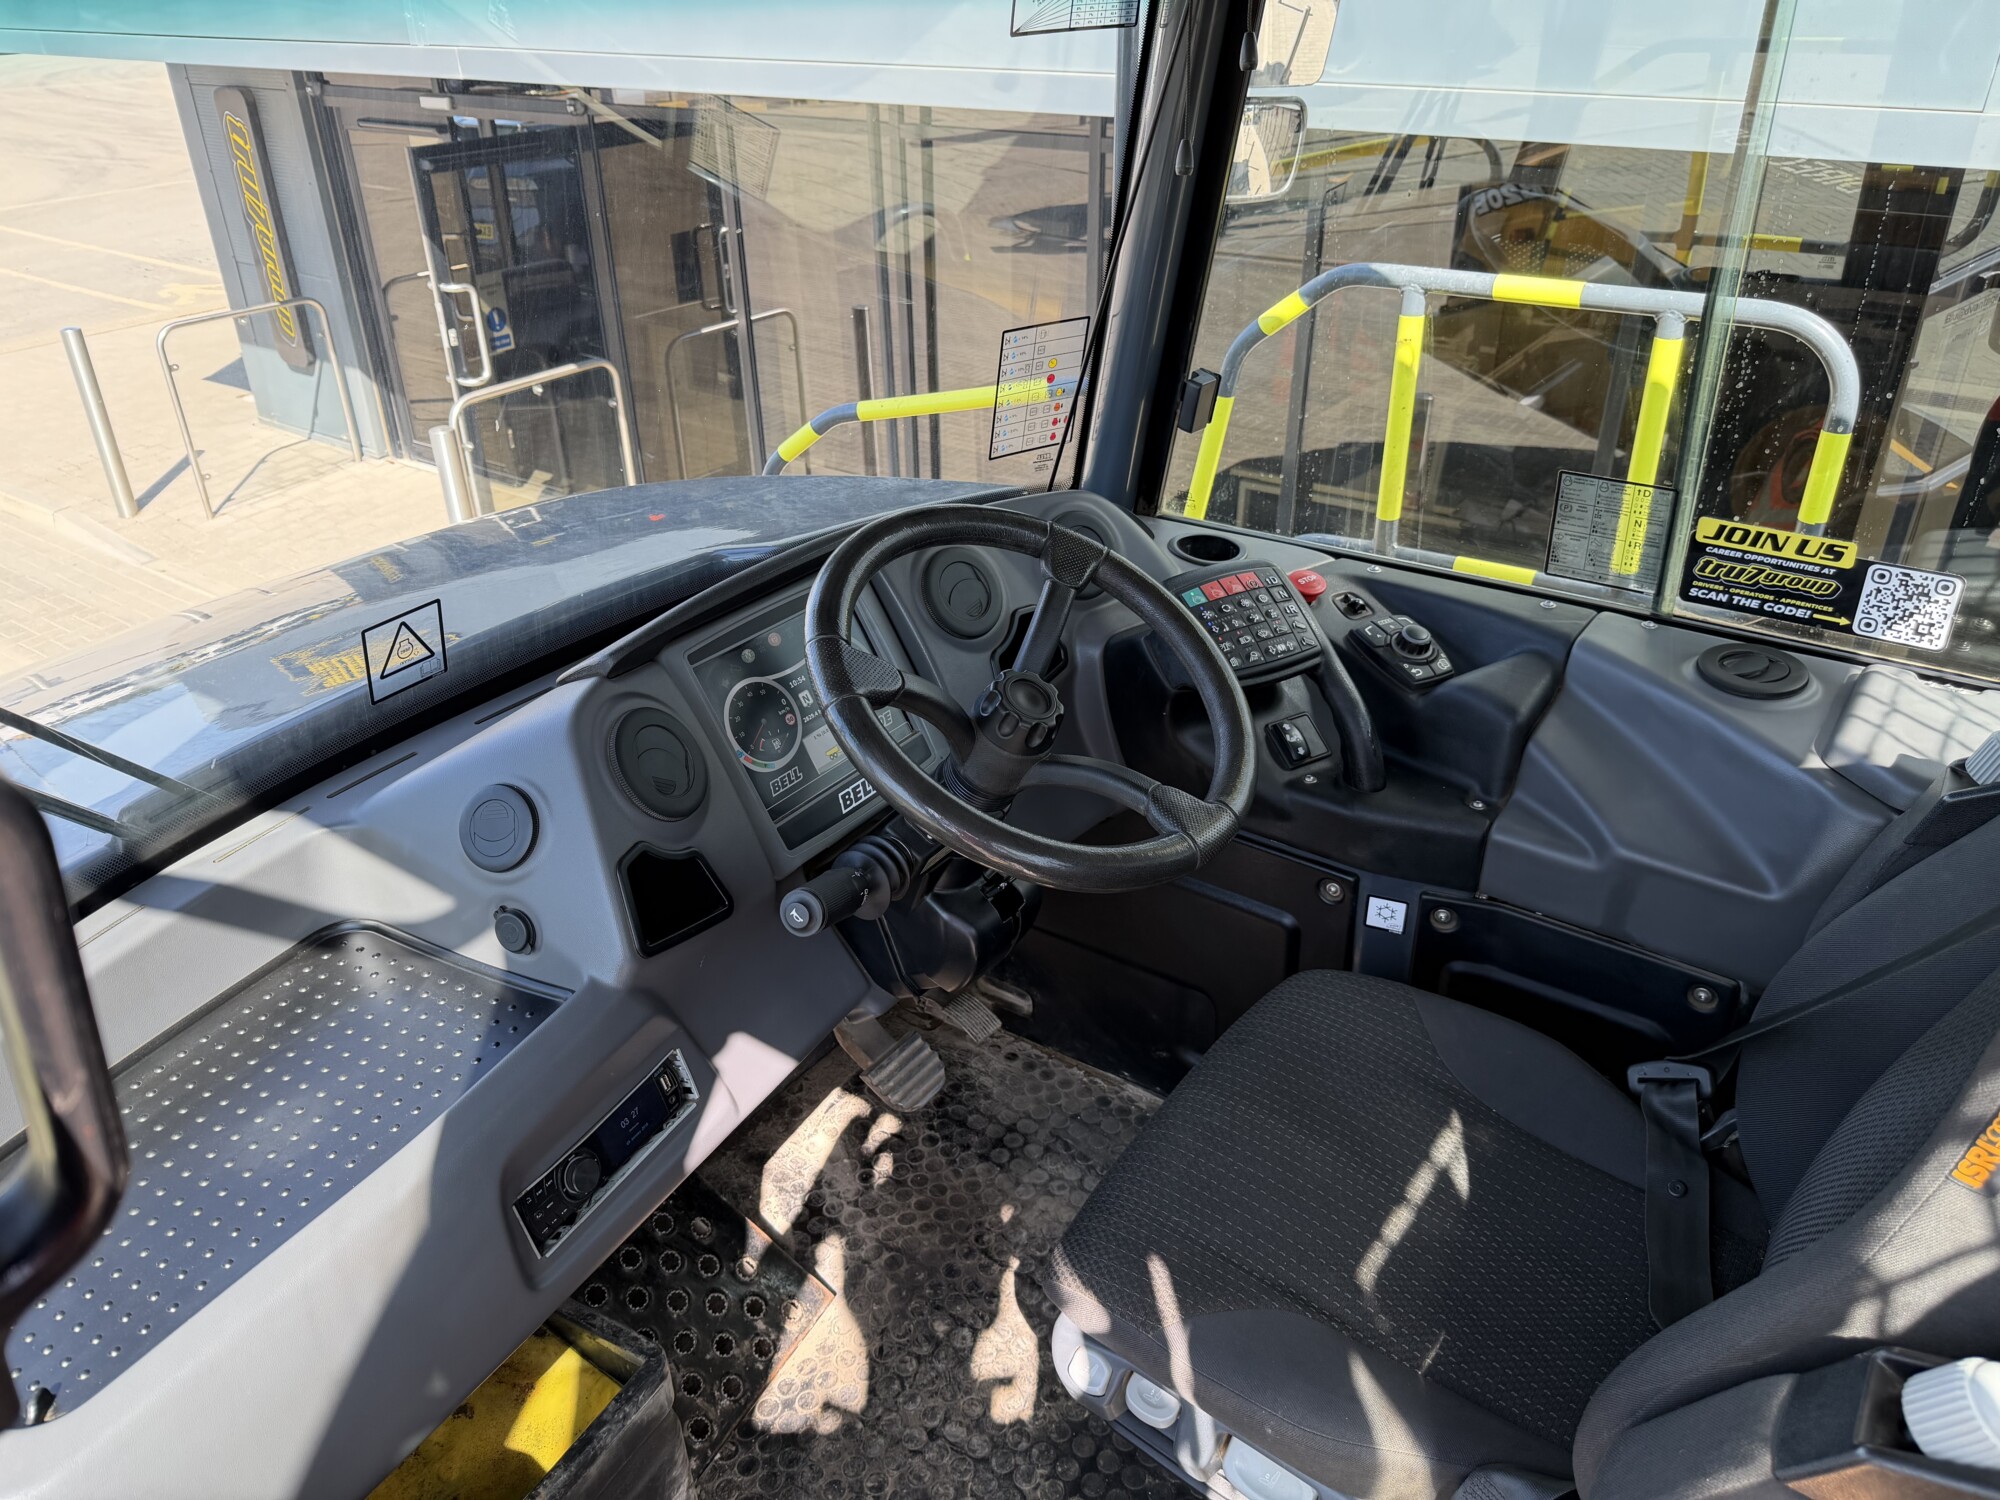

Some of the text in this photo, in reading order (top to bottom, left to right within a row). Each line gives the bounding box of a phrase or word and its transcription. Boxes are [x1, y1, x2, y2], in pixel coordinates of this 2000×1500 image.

[1702, 523, 1849, 563] JOIN US
[1694, 556, 1838, 596] tru7group
[1705, 546, 1837, 575] CAREER OPPORTUNITIES AT
[1298, 575, 1317, 585] STOP
[1688, 587, 1812, 619] SCAN THE CODE!
[1692, 580, 1834, 613] DRIVERS OPERATORS APPRENTICES
[789, 675, 806, 689] 10:54
[769, 766, 803, 797] BELL
[838, 777, 877, 815] BEL
